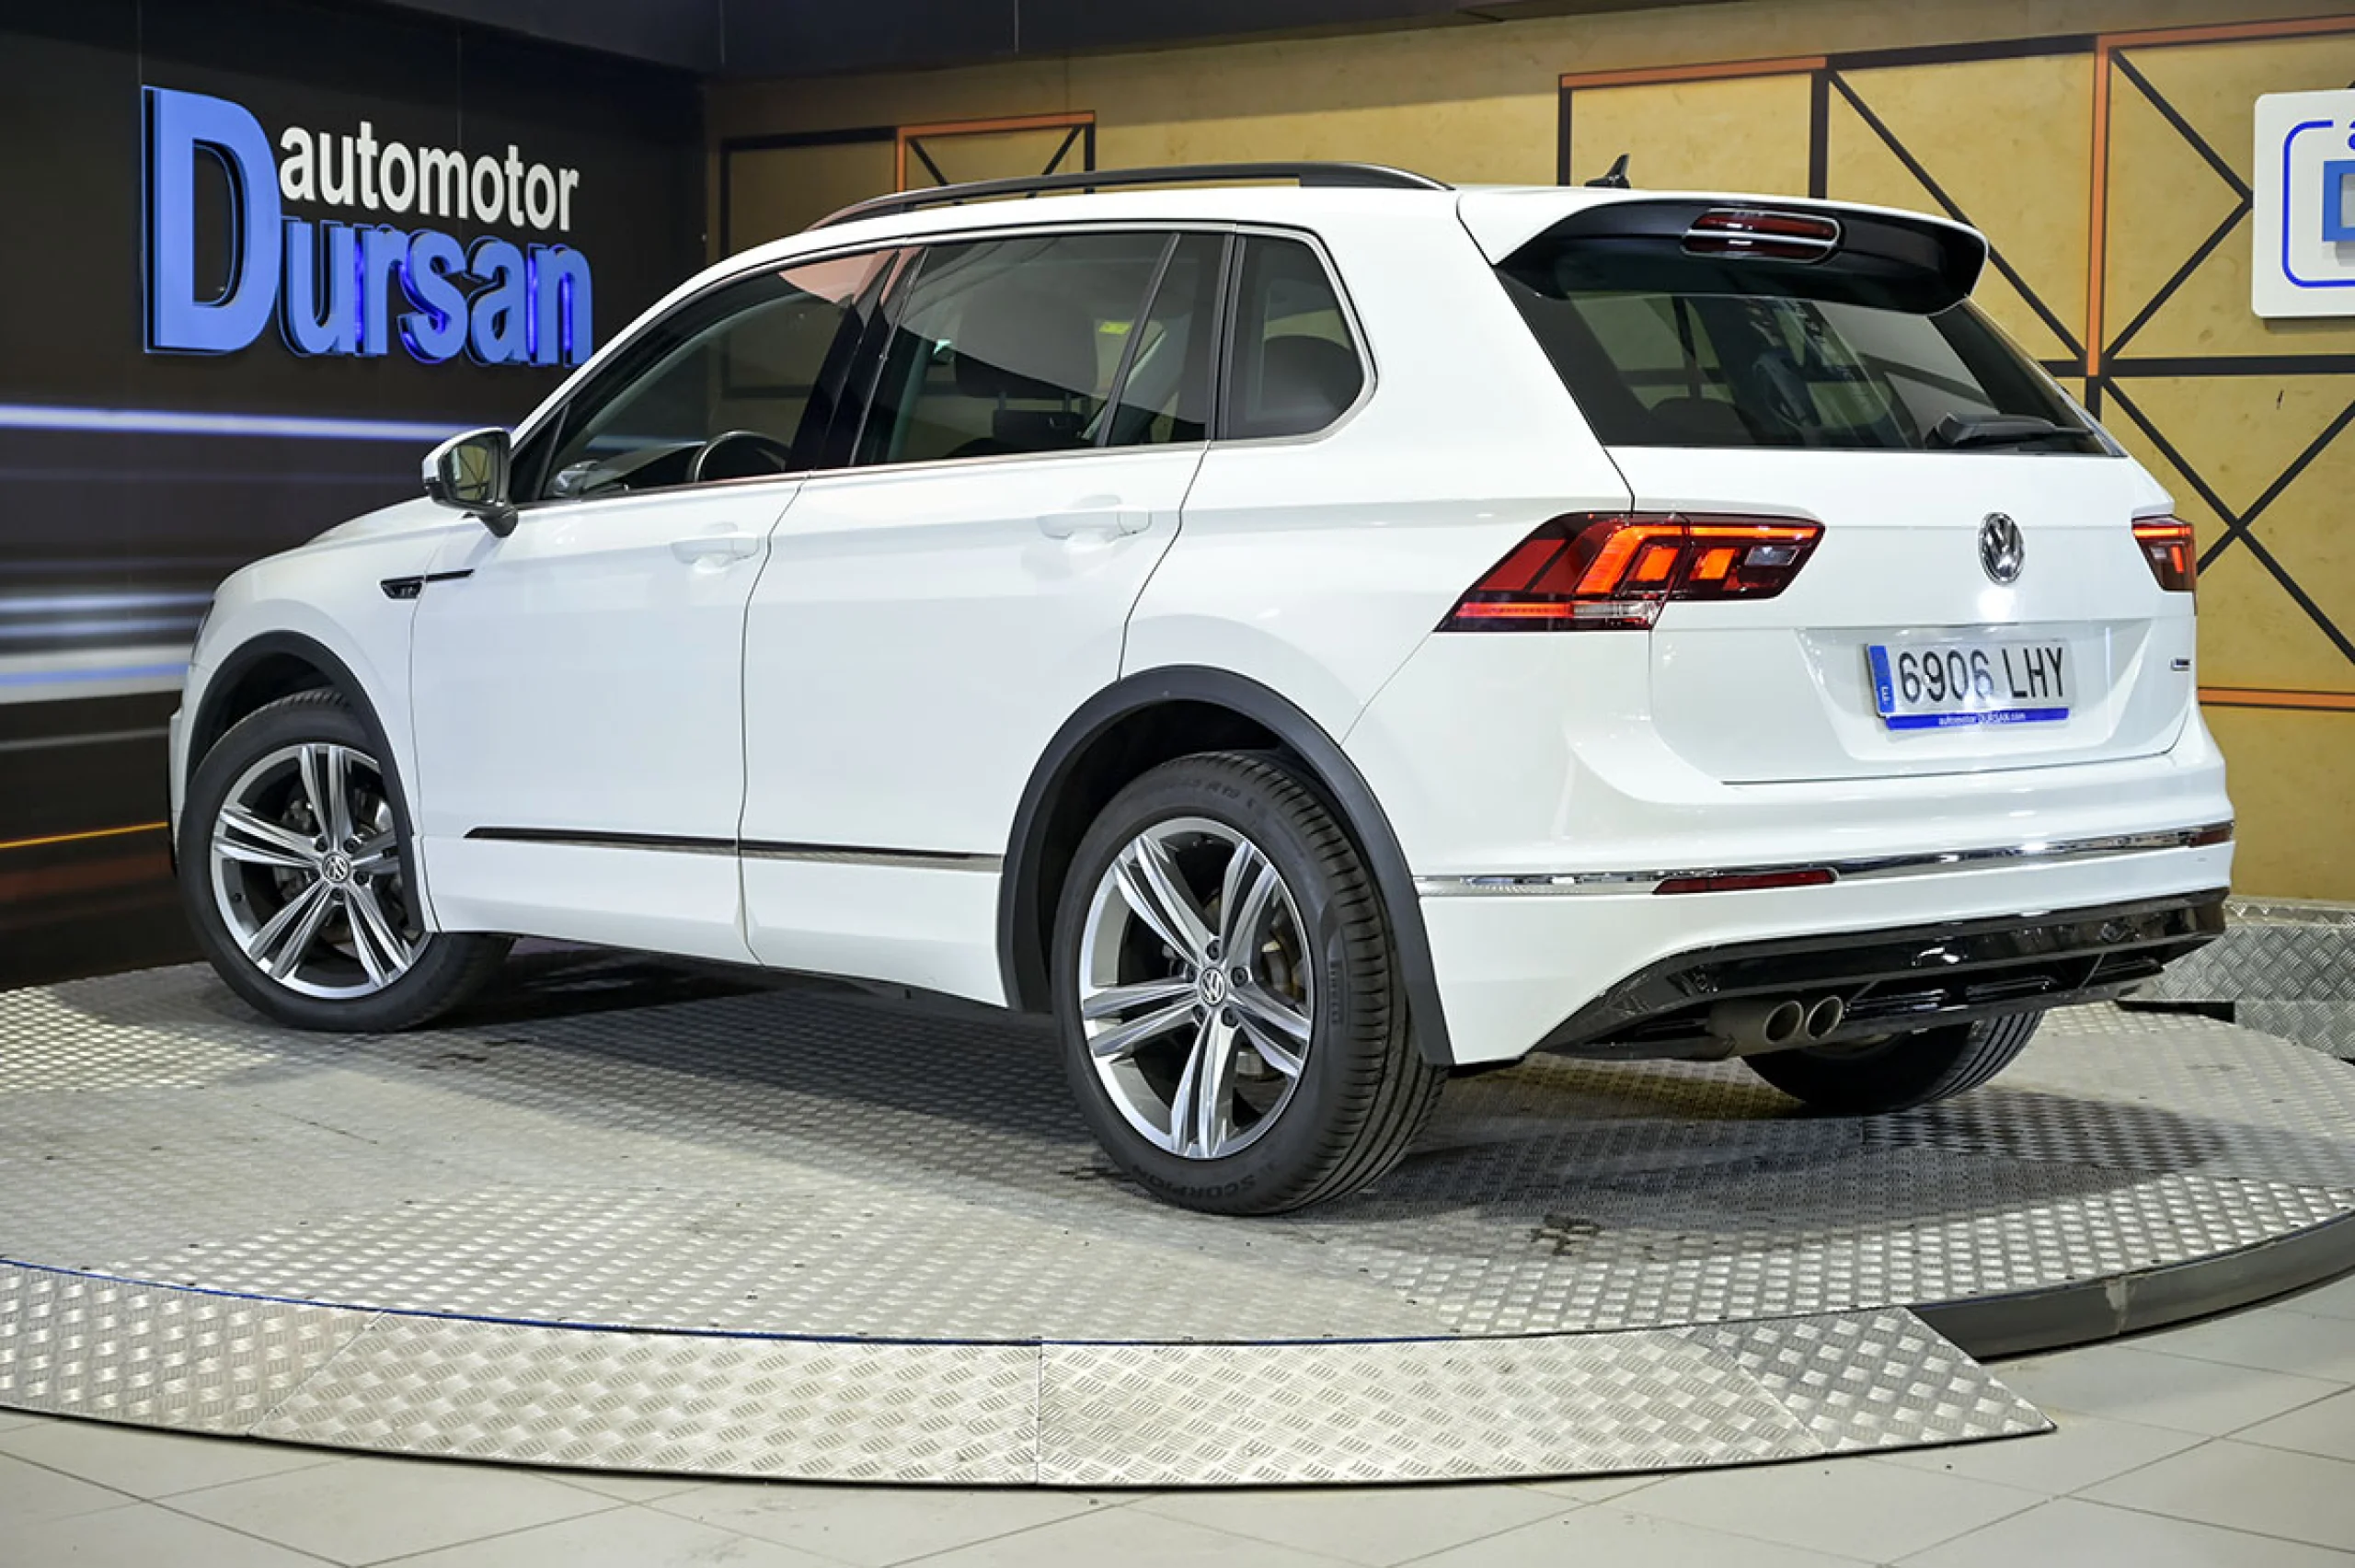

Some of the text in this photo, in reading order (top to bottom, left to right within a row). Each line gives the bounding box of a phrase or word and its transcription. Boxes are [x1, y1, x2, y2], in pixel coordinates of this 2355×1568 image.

[142, 85, 593, 366] Dursan
[280, 120, 580, 232] automotor
[1898, 647, 2063, 704] 6906 LHY
